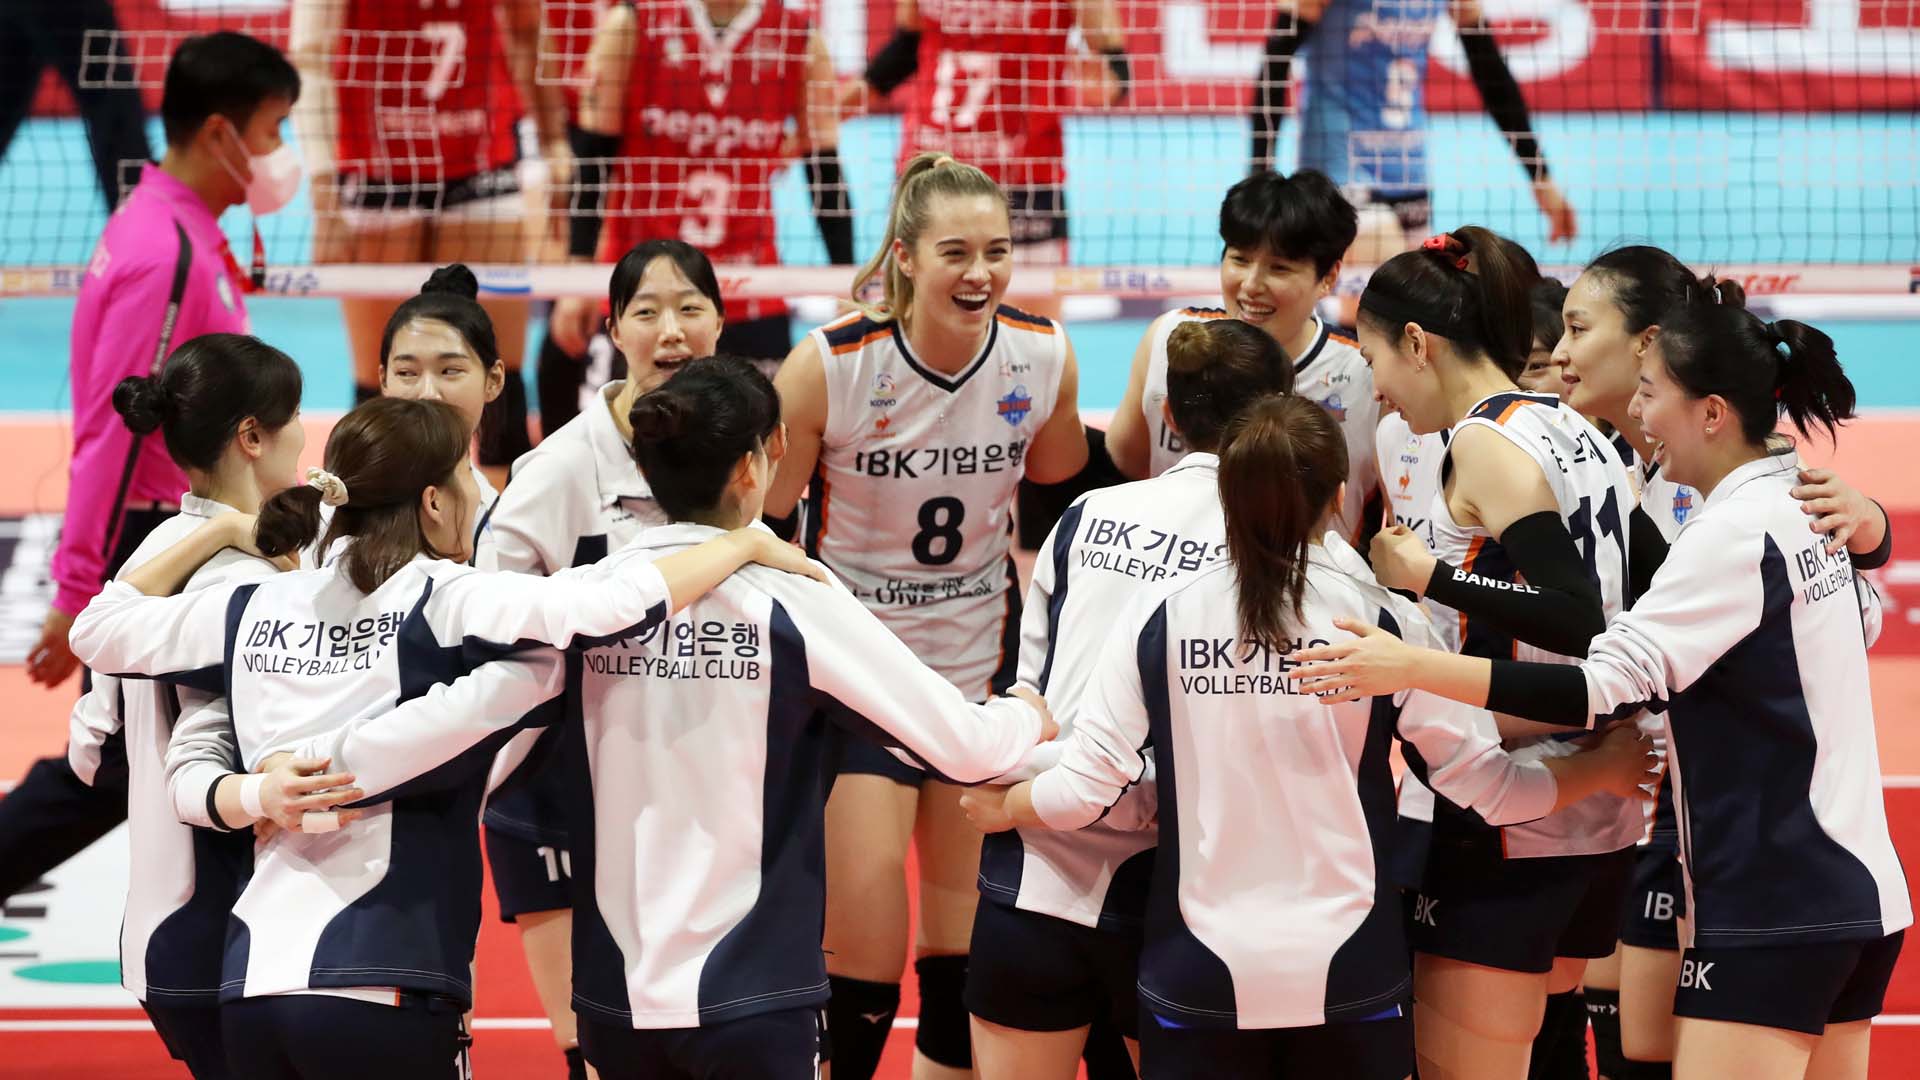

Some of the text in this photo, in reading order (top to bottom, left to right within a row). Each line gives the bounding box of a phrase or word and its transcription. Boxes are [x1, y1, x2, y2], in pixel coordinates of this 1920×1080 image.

[420, 23, 466, 99] 7
[931, 51, 1000, 127] 17
[679, 170, 730, 247] 3
[855, 438, 1028, 479] IBK 기업은행
[911, 496, 966, 566] 8
[1084, 518, 1228, 573] IBK 기업
[1080, 549, 1179, 583] VOLLEYB
[1795, 541, 1826, 583] IBK
[1451, 567, 1541, 595] BANDEL
[245, 611, 406, 658] IBK 기업은행
[243, 650, 381, 677] VOLLEYBALL CL
[584, 654, 761, 681] VOLLEYBALL CLUB
[1180, 637, 1235, 670] IBK
[1414, 893, 1440, 927] BK
[1643, 890, 1675, 922] IB
[1677, 959, 1716, 991] BK
